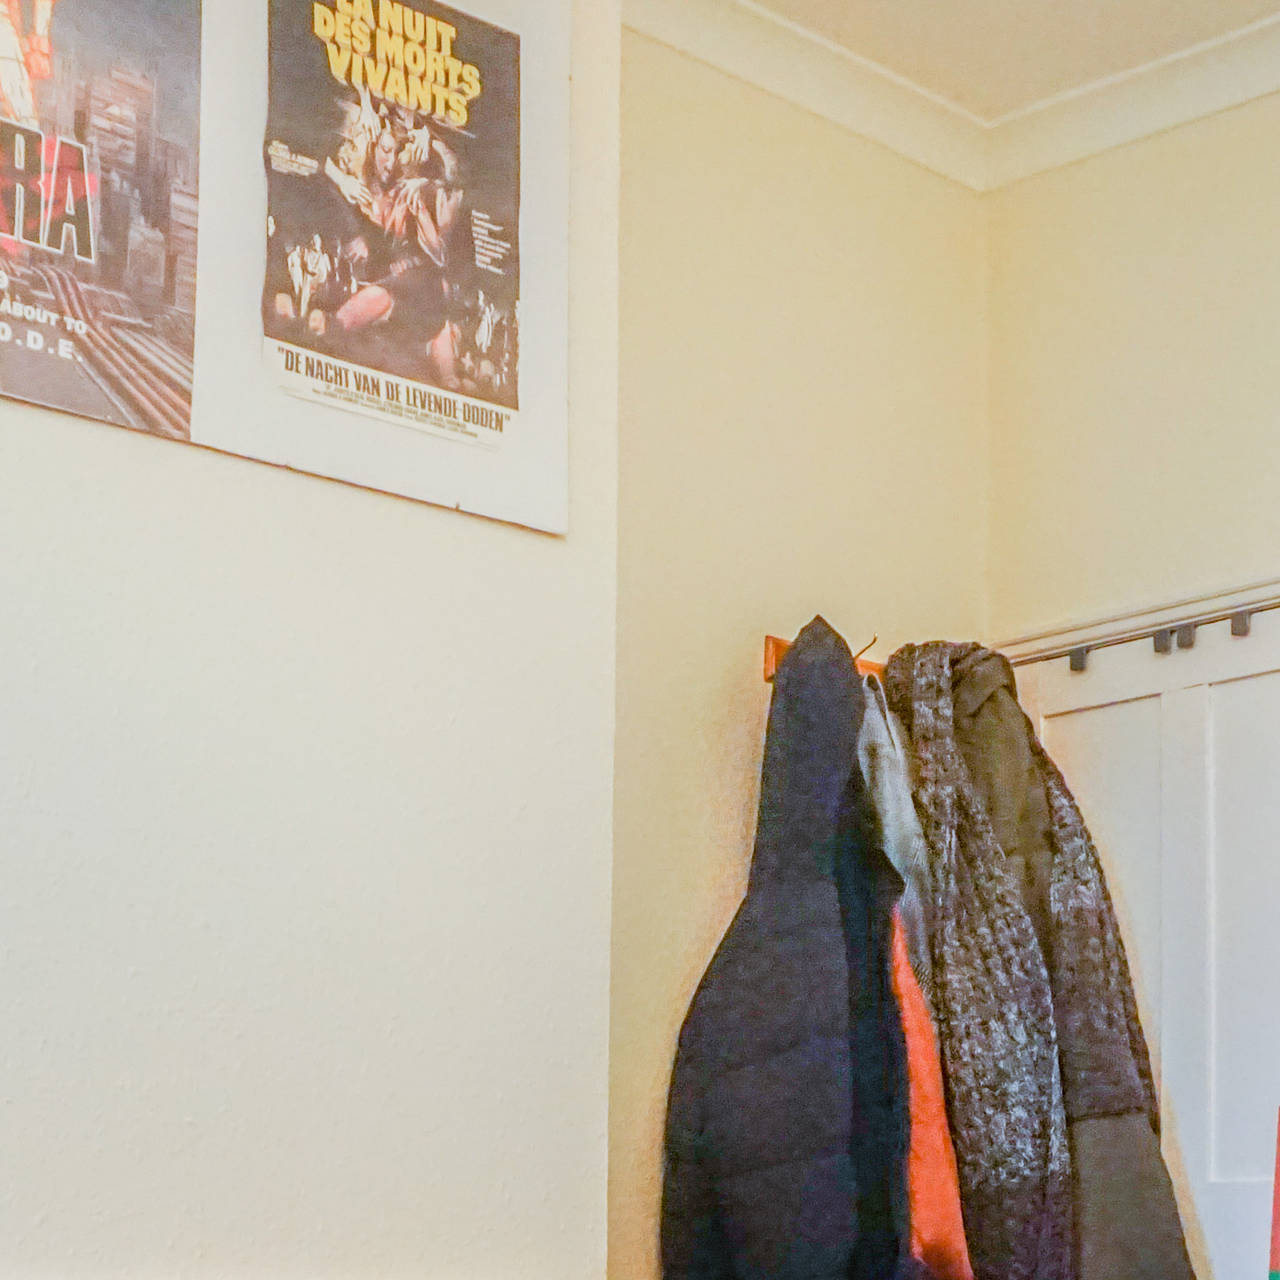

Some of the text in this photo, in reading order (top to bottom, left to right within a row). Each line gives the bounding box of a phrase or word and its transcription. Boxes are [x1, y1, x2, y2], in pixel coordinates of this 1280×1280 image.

[313, 2, 481, 99] DES MORTS
[379, 0, 457, 55] NUIT
[326, 40, 468, 127] VIVANTS
[0, 300, 60, 326] ABOUT
[63, 316, 87, 335] TO
[305, 355, 349, 386] NACHT
[354, 370, 381, 397] VAN
[385, 380, 401, 402] DE
[406, 386, 459, 420] LEVENDE
